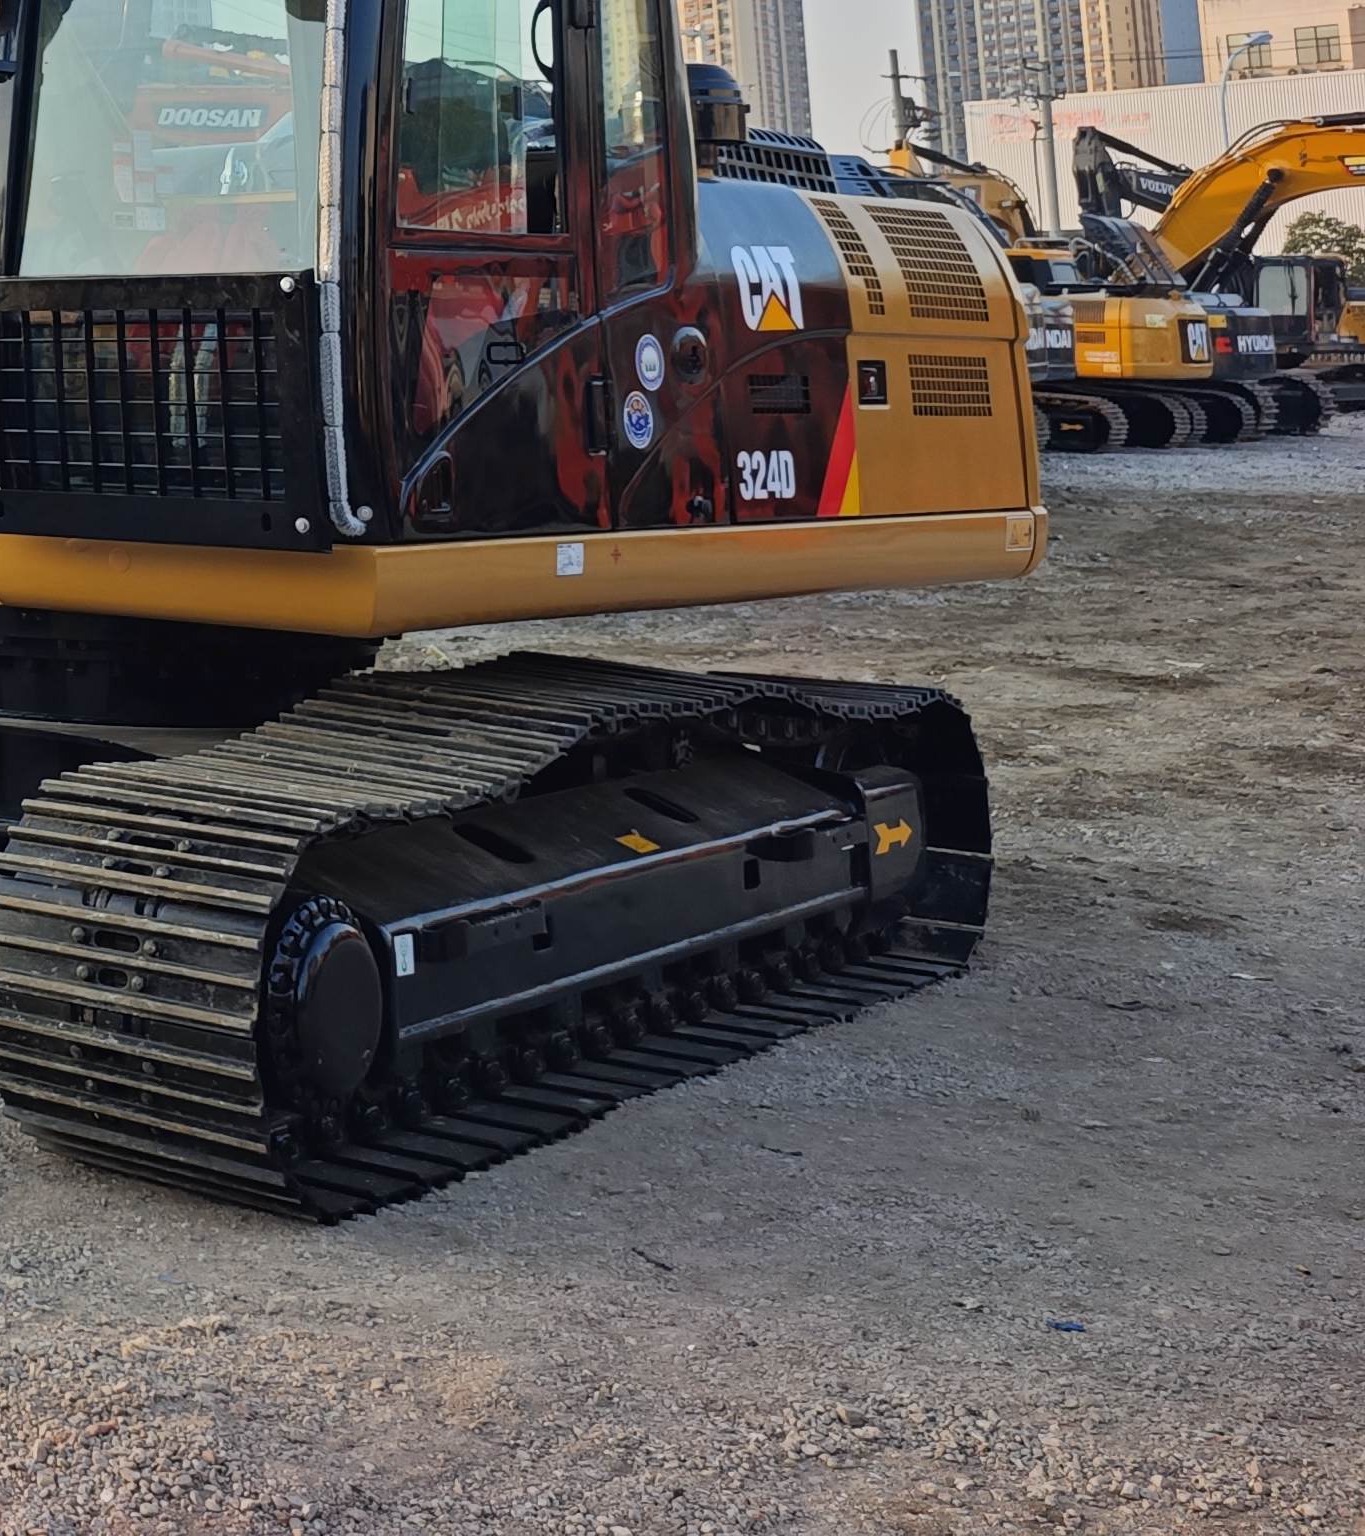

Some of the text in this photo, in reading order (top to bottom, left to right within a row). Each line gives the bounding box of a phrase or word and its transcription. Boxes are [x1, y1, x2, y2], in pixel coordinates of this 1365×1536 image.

[157, 107, 262, 128] DOOSAN
[1139, 177, 1175, 196] VOLVO
[731, 246, 804, 331] CAT
[1045, 329, 1072, 349] NDAI
[1187, 323, 1208, 361] CAT
[1237, 335, 1274, 352] HYUNDA
[736, 450, 796, 501] 324D
